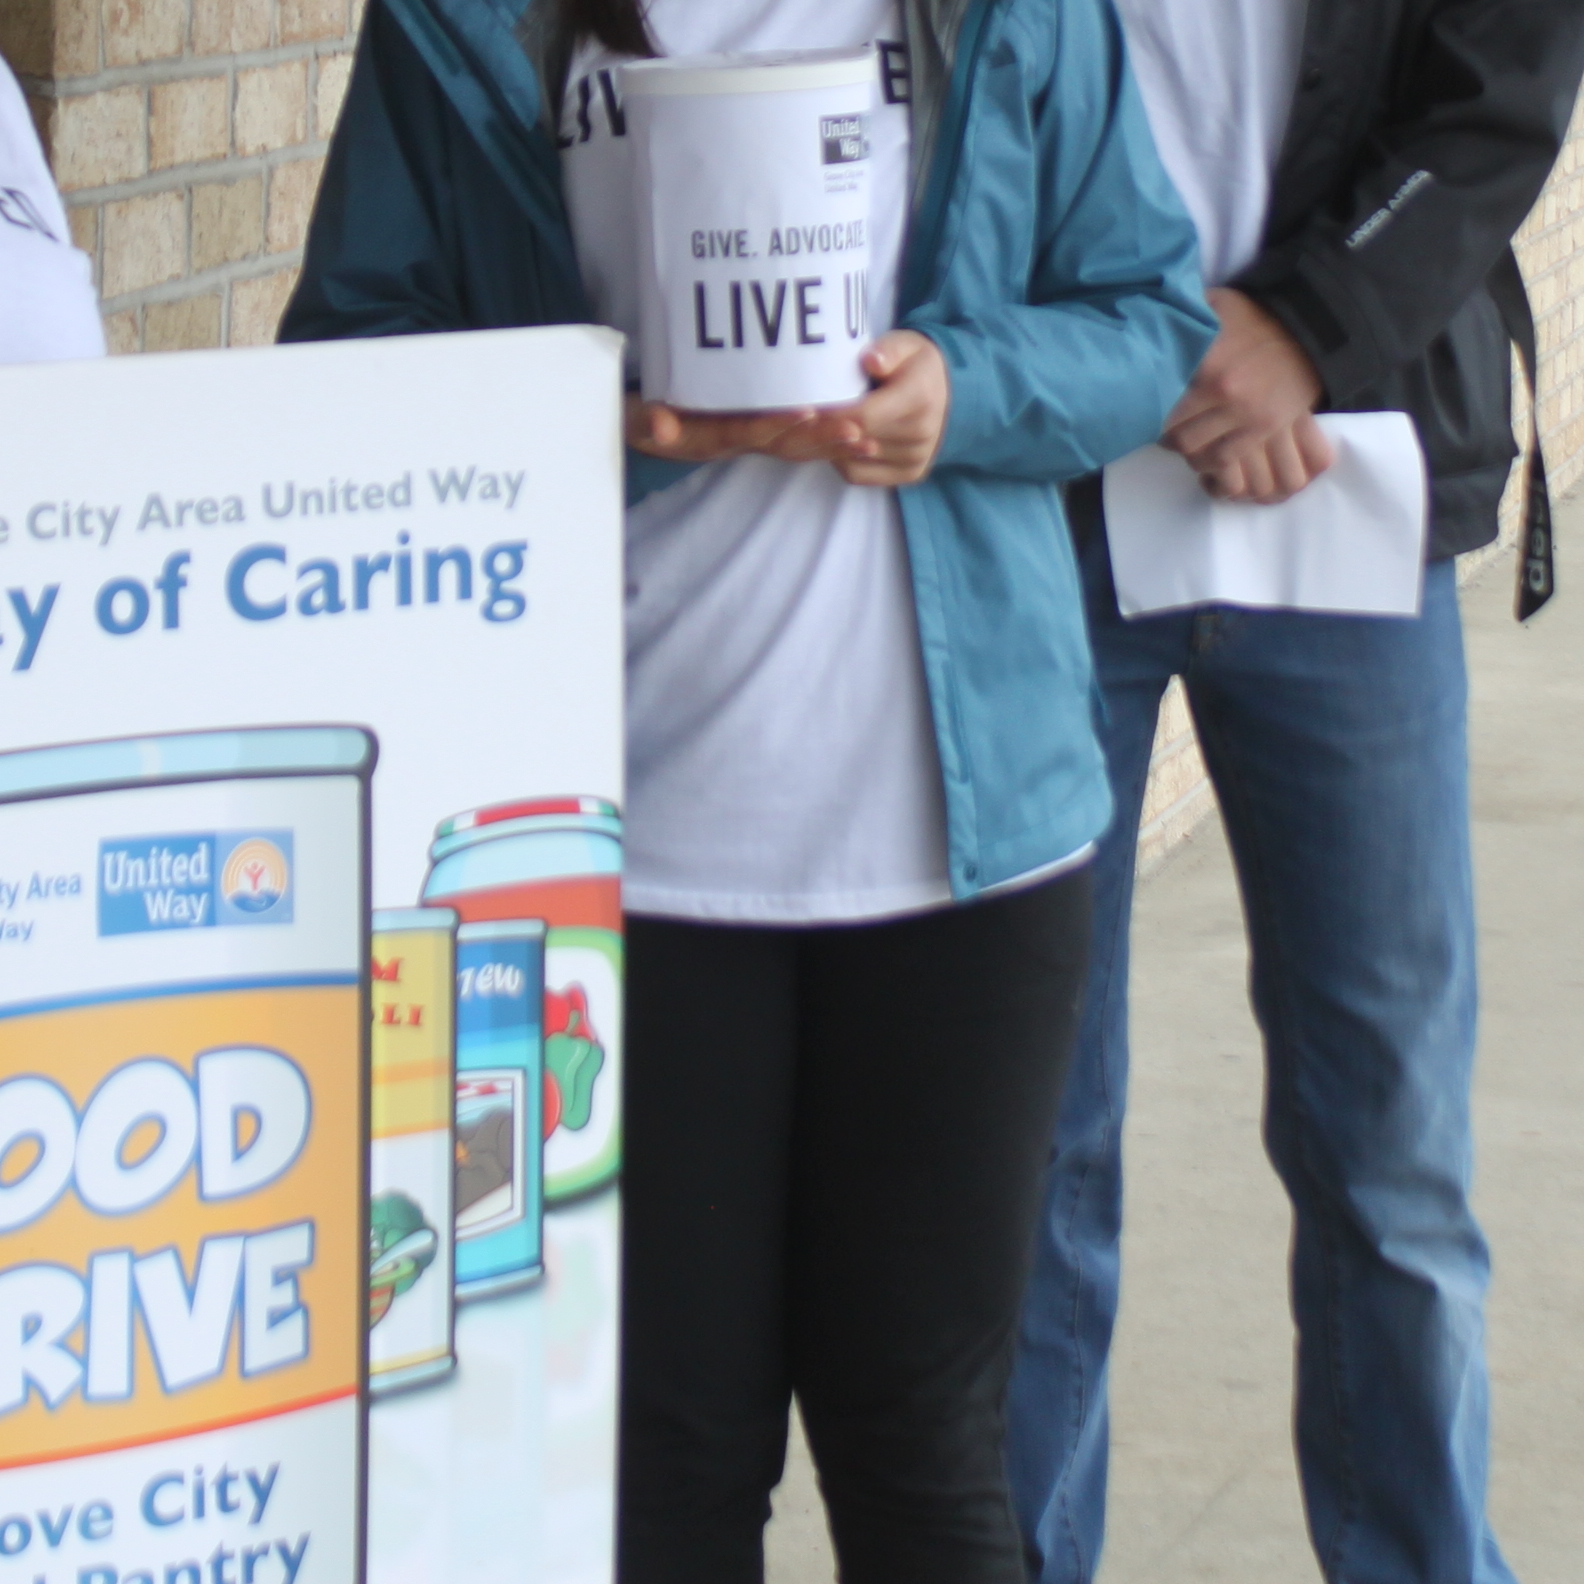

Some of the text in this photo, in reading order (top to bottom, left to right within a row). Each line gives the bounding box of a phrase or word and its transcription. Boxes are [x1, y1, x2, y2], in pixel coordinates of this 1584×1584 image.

[821, 118, 860, 138] United
[691, 229, 758, 259] GIVE.
[693, 275, 826, 349] LIVE
[27, 501, 121, 545] City
[136, 493, 245, 532] Area
[261, 472, 413, 518] United
[427, 465, 526, 508] Way
[93, 549, 192, 636] of
[224, 528, 528, 623] Caring
[27, 870, 82, 901] Area
[102, 842, 210, 891] United
[143, 890, 209, 924] Way
[139, 1461, 281, 1526] City
